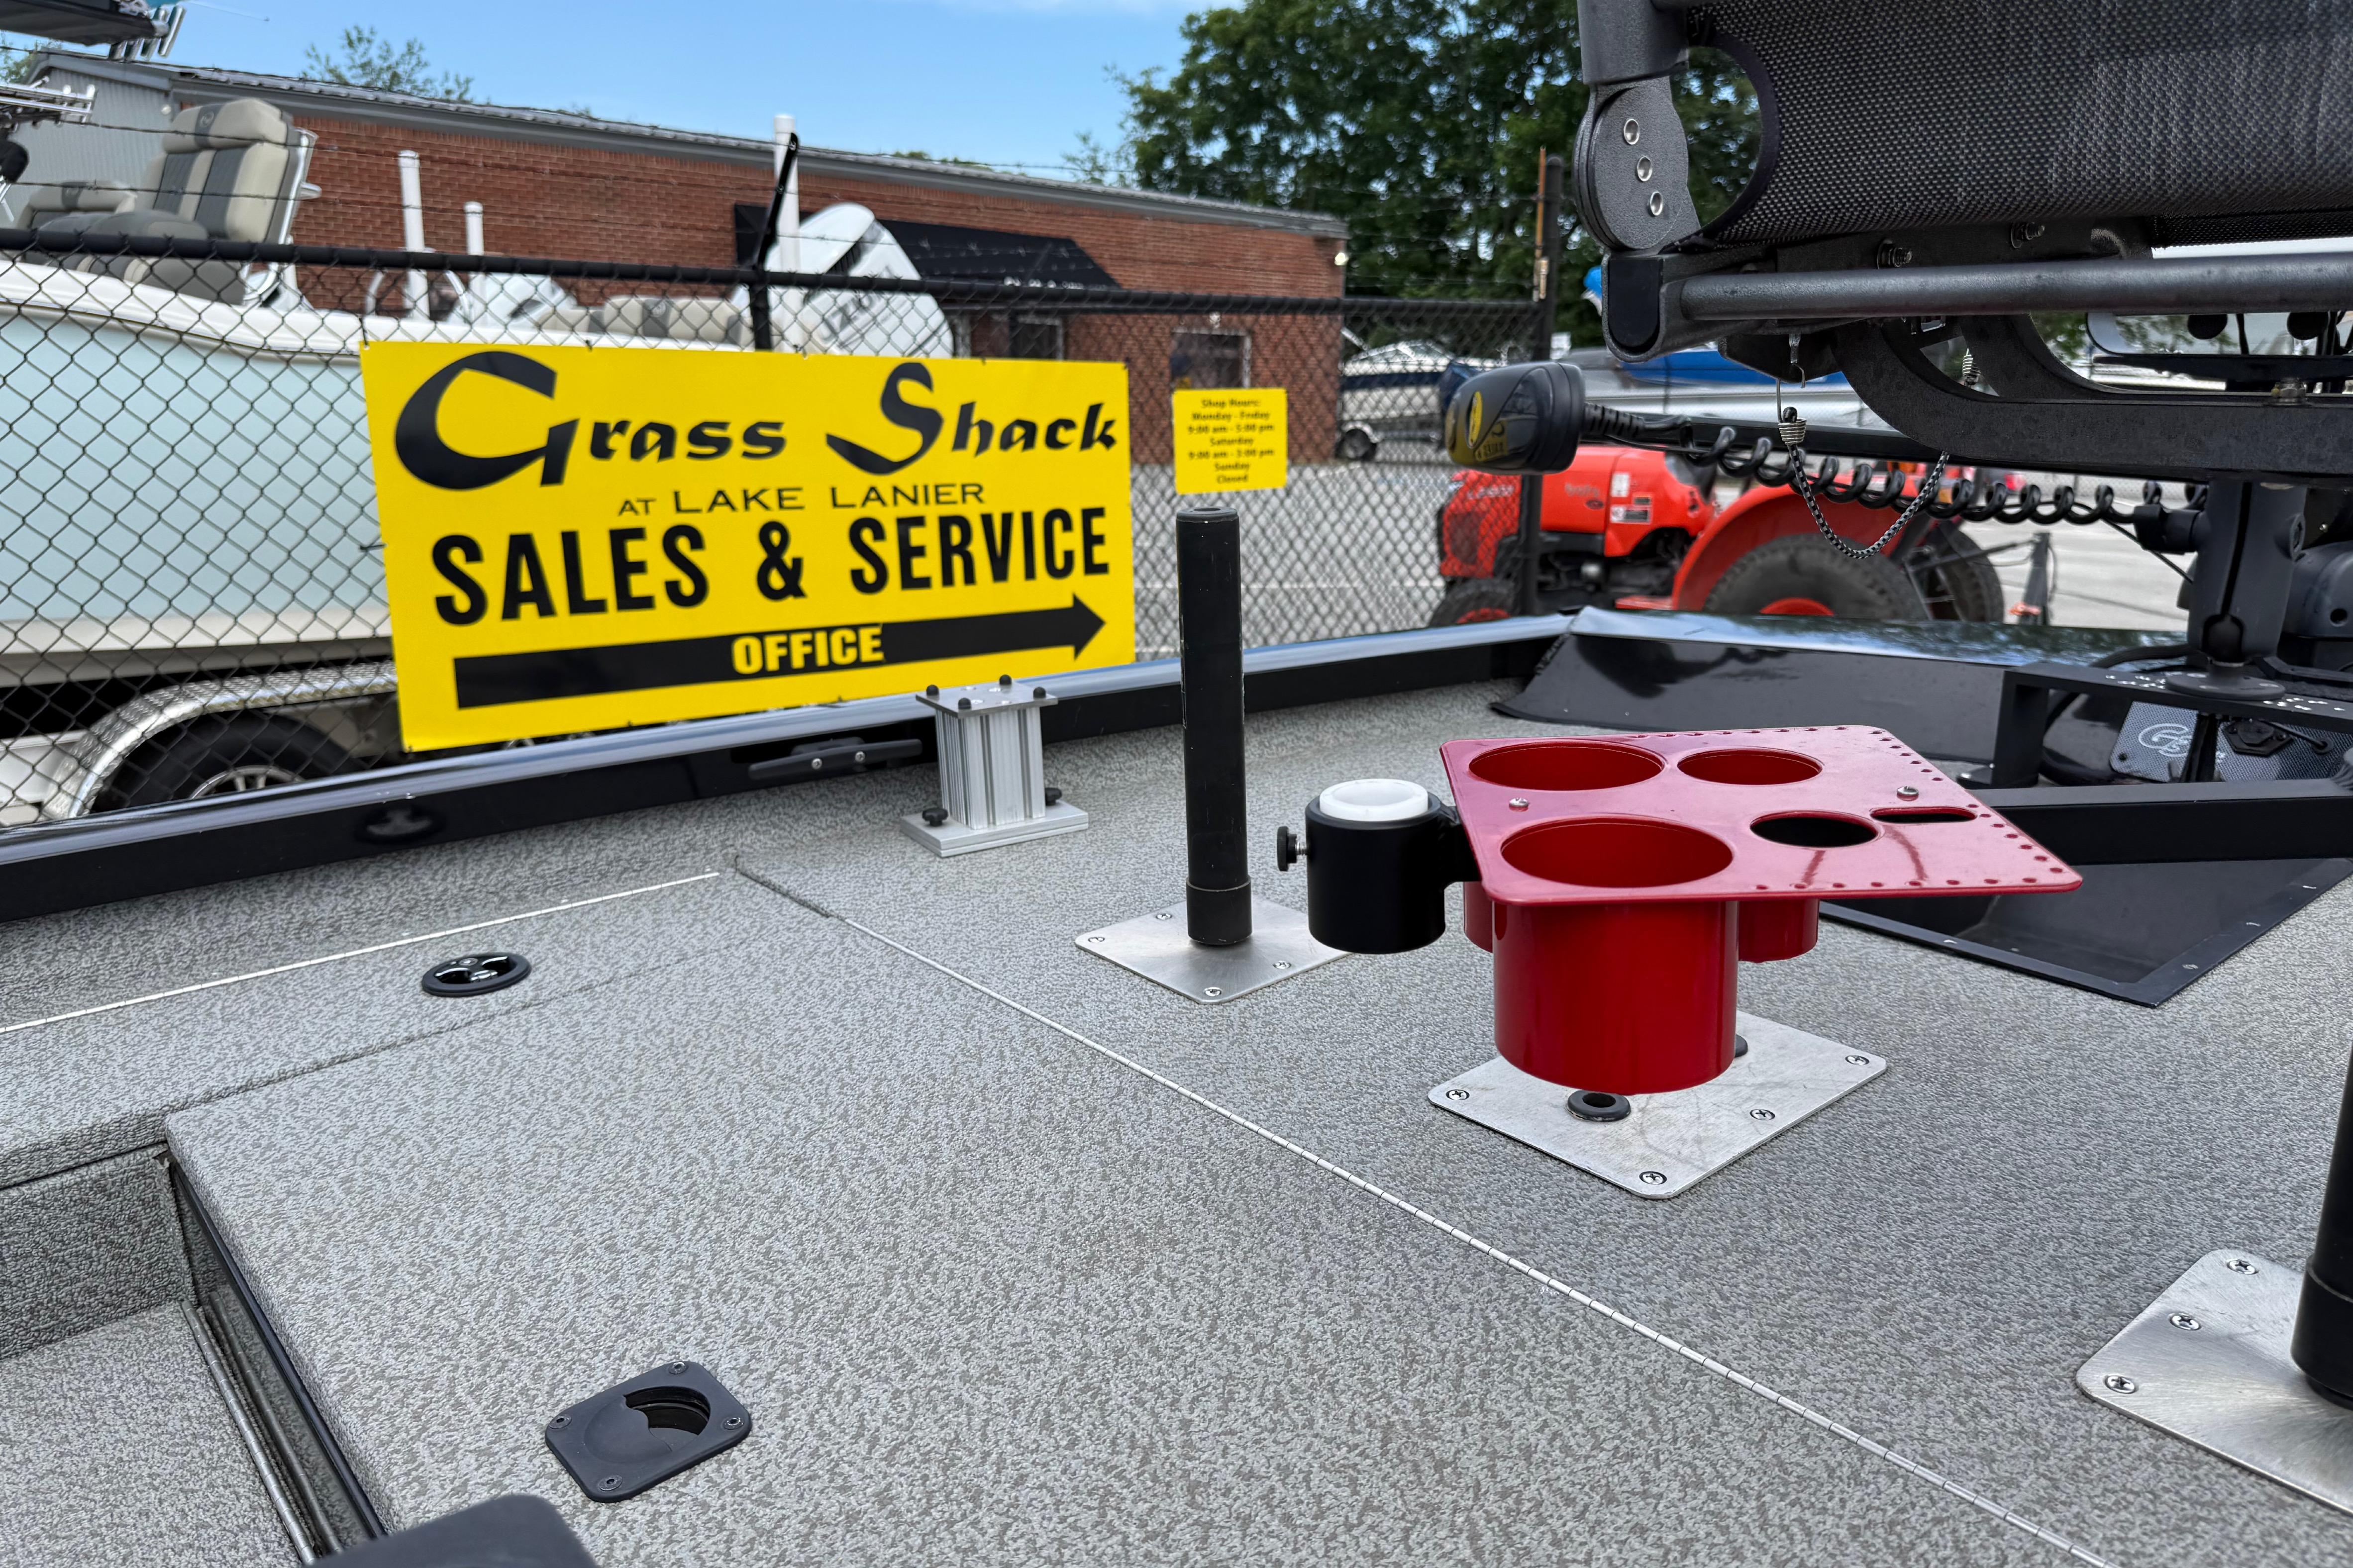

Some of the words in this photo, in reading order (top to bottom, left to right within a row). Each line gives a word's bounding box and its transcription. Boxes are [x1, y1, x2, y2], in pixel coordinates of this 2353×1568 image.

[394, 350, 787, 492] Grass
[825, 362, 1117, 476] Shack
[1192, 412, 1232, 421] Monday
[1240, 411, 1270, 420] Friday
[1259, 424, 1274, 433] pm
[1210, 437, 1254, 446] Saturday
[1215, 462, 1250, 472] Sunday
[1217, 474, 1248, 483] Closed
[618, 499, 656, 516] AT
[674, 487, 804, 513] LAKE
[831, 483, 983, 508] LANIER
[431, 524, 709, 626] SALES
[756, 520, 807, 602] &
[848, 506, 1110, 595] SERVICE
[732, 627, 885, 675] OFFICE
